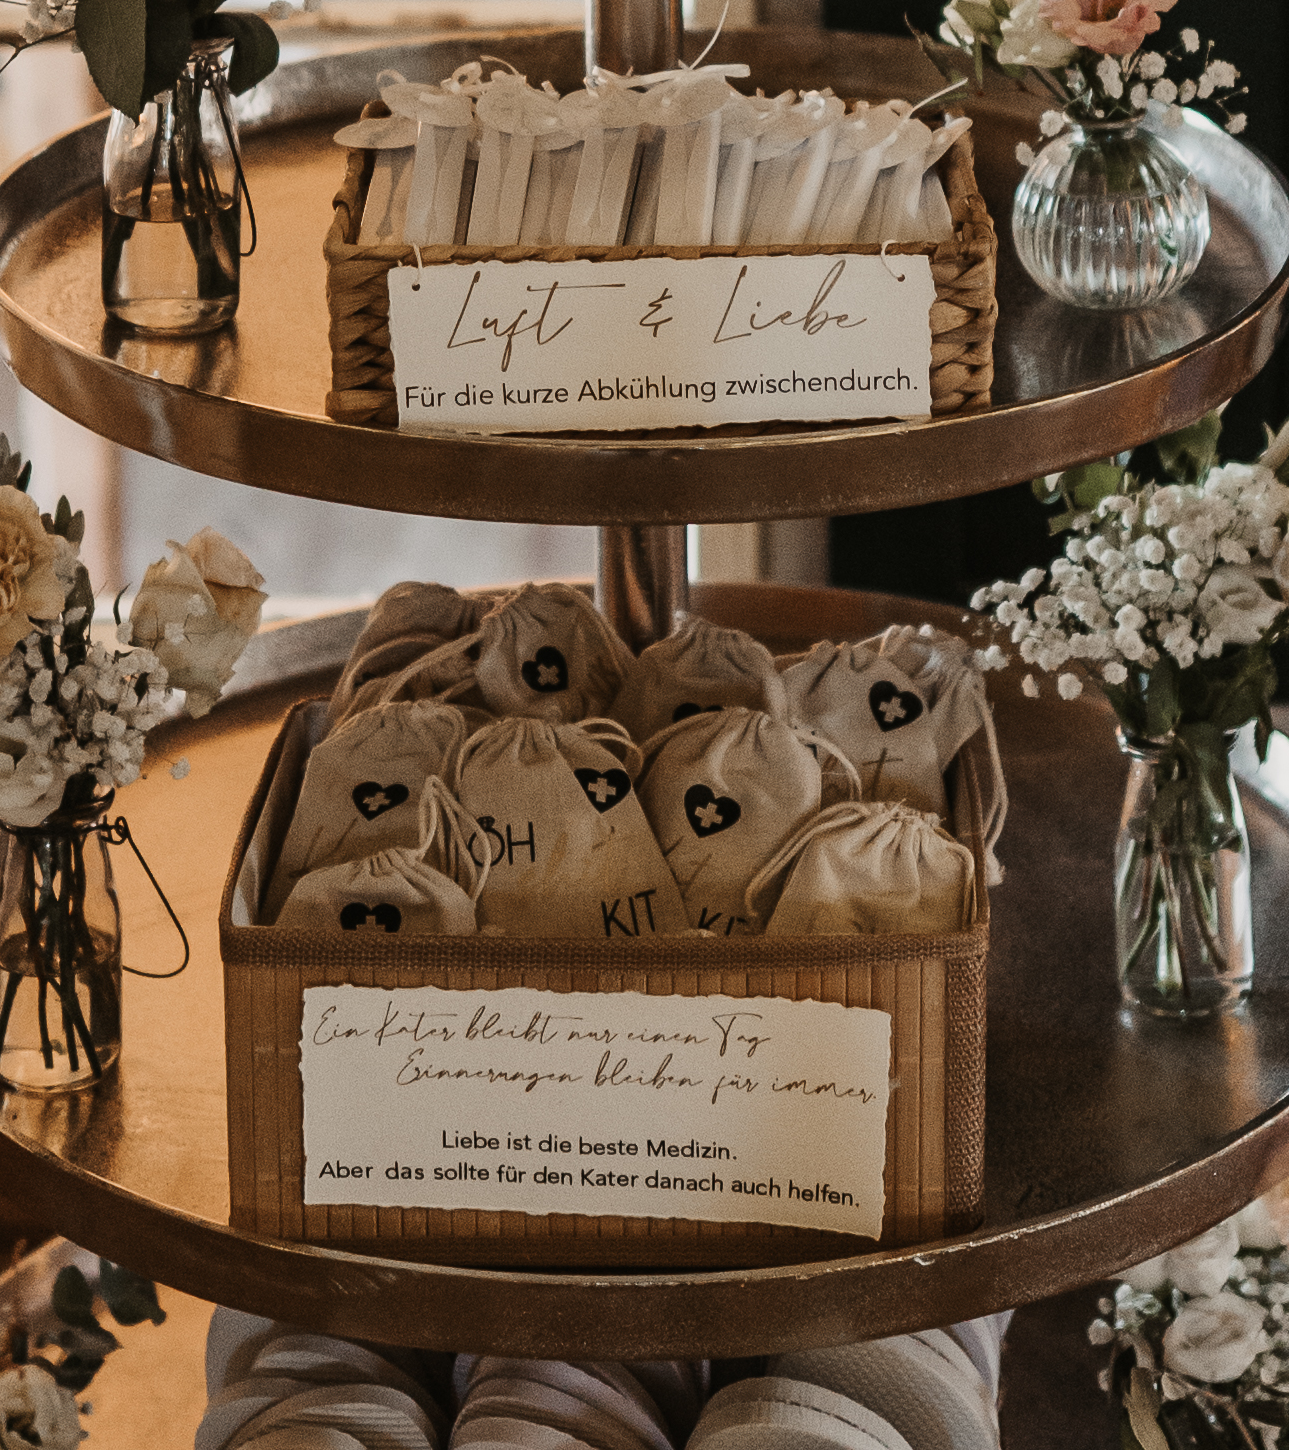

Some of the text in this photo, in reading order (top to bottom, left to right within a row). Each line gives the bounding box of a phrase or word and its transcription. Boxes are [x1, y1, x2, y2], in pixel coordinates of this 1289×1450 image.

[446, 259, 867, 373] Luft & Liebe
[404, 367, 918, 409] Für die kurze Abkühlung zwischendurch.
[600, 888, 657, 937] KIT
[312, 1000, 771, 1058] Ein Kater bleibt nur einen Tag
[396, 1047, 876, 1105] Erinnerungen bleiben für immer.
[441, 1129, 737, 1161] Liebe ist die beste Medizin.
[318, 1160, 860, 1208] Aber das sollte für den Kater danach auch helfen.
